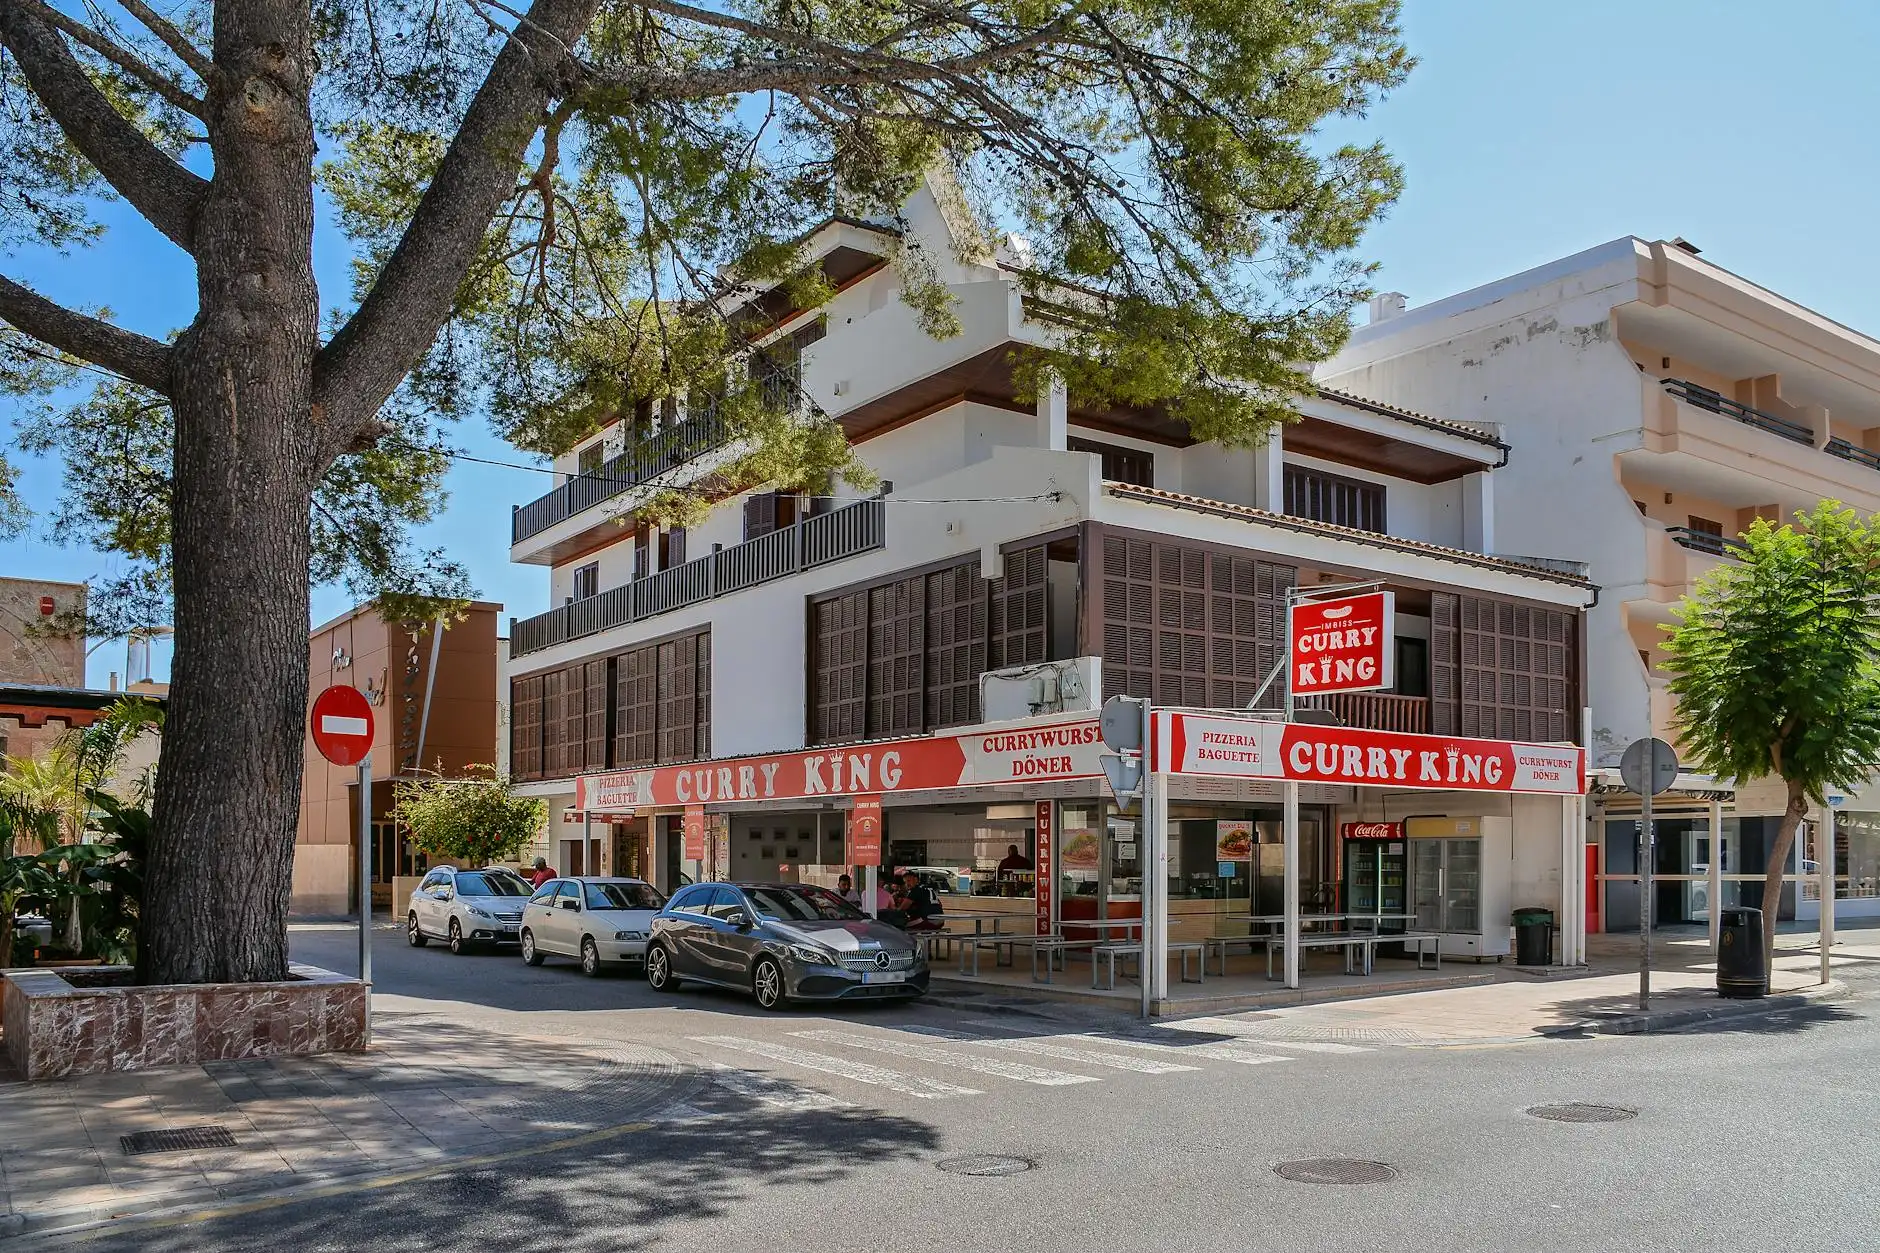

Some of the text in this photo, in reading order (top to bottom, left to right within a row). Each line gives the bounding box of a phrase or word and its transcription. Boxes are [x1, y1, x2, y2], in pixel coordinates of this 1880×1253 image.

[1321, 620, 1353, 631] IMBISS
[1298, 626, 1378, 653] CURRY
[1298, 656, 1376, 686] KING
[983, 726, 1104, 753] CURRYWURST
[1202, 732, 1257, 747] PIZZERIA
[1198, 748, 1260, 763] BAGUETTE
[1289, 741, 1503, 785] CURRY KING
[1519, 756, 1573, 769] CURRYWURST
[1012, 754, 1072, 776] DÖNER
[599, 775, 635, 789] PIZZERIA
[676, 751, 902, 801] CURRY KING
[1533, 769, 1560, 781] DÖNER
[597, 791, 637, 805] BAGUETTE
[1039, 804, 1049, 942] CURRYWURS
